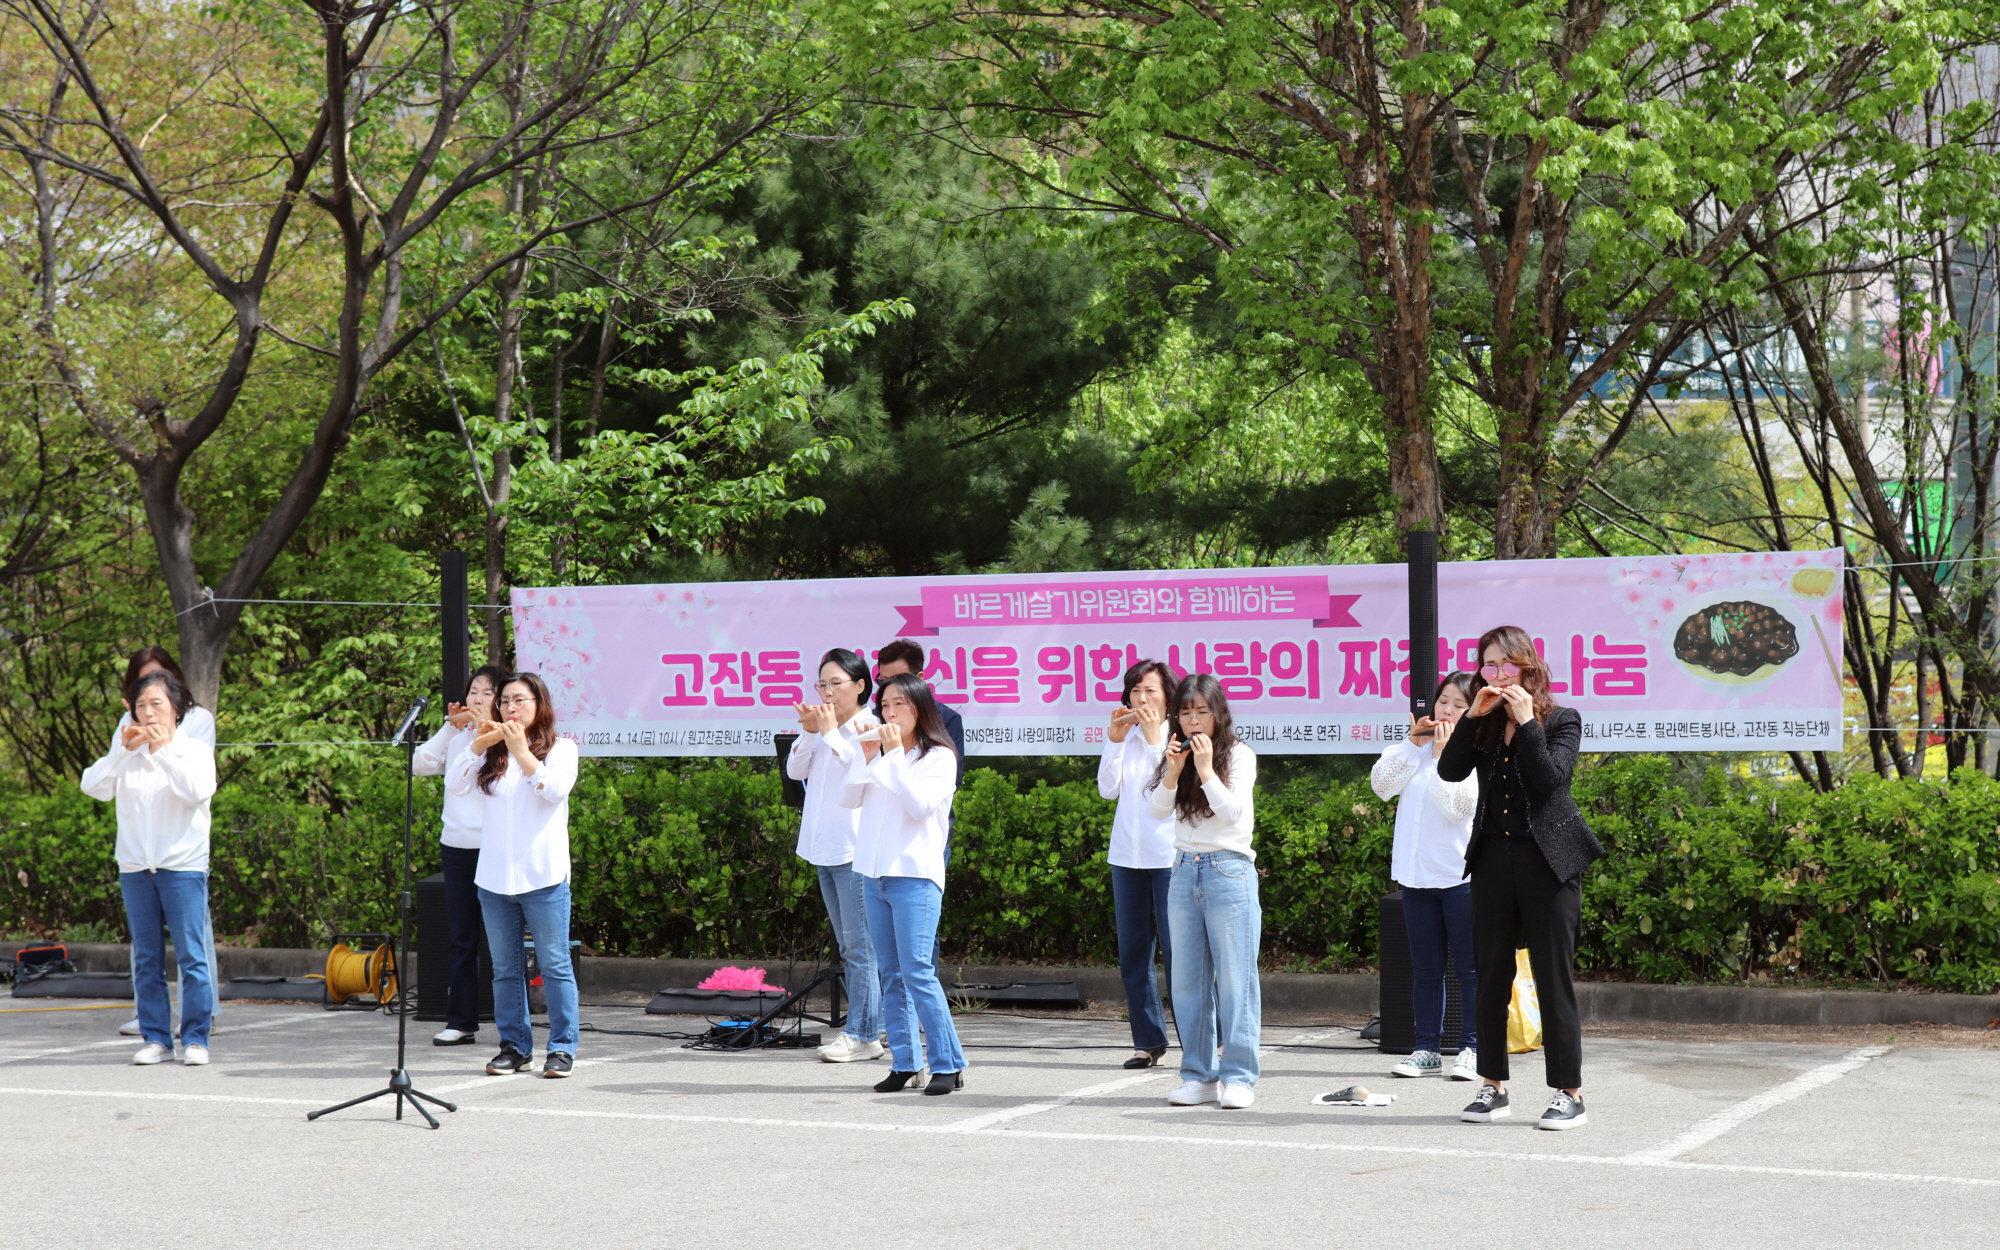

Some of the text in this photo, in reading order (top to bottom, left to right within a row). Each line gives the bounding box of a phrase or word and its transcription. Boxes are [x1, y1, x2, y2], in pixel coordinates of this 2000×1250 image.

[954, 585, 1295, 619] 바르게살기위원회와 함께하는
[662, 650, 803, 706] 고잔동
[1037, 643, 1141, 702] 위한
[588, 732, 612, 745] 2023.
[659, 731, 678, 745] 10시
[688, 730, 741, 745] 원고잔공원내
[744, 729, 772, 745] 주차장
[1016, 727, 1075, 743] 사랑의짜장차
[1084, 726, 1104, 743] 공연
[1282, 724, 1313, 742] 색소폰
[1351, 724, 1371, 741] 후원
[1602, 722, 1651, 740] 나무스푼,
[1654, 721, 1740, 739] 필라멘트봉사단,
[1744, 720, 1779, 738] 고잔동
